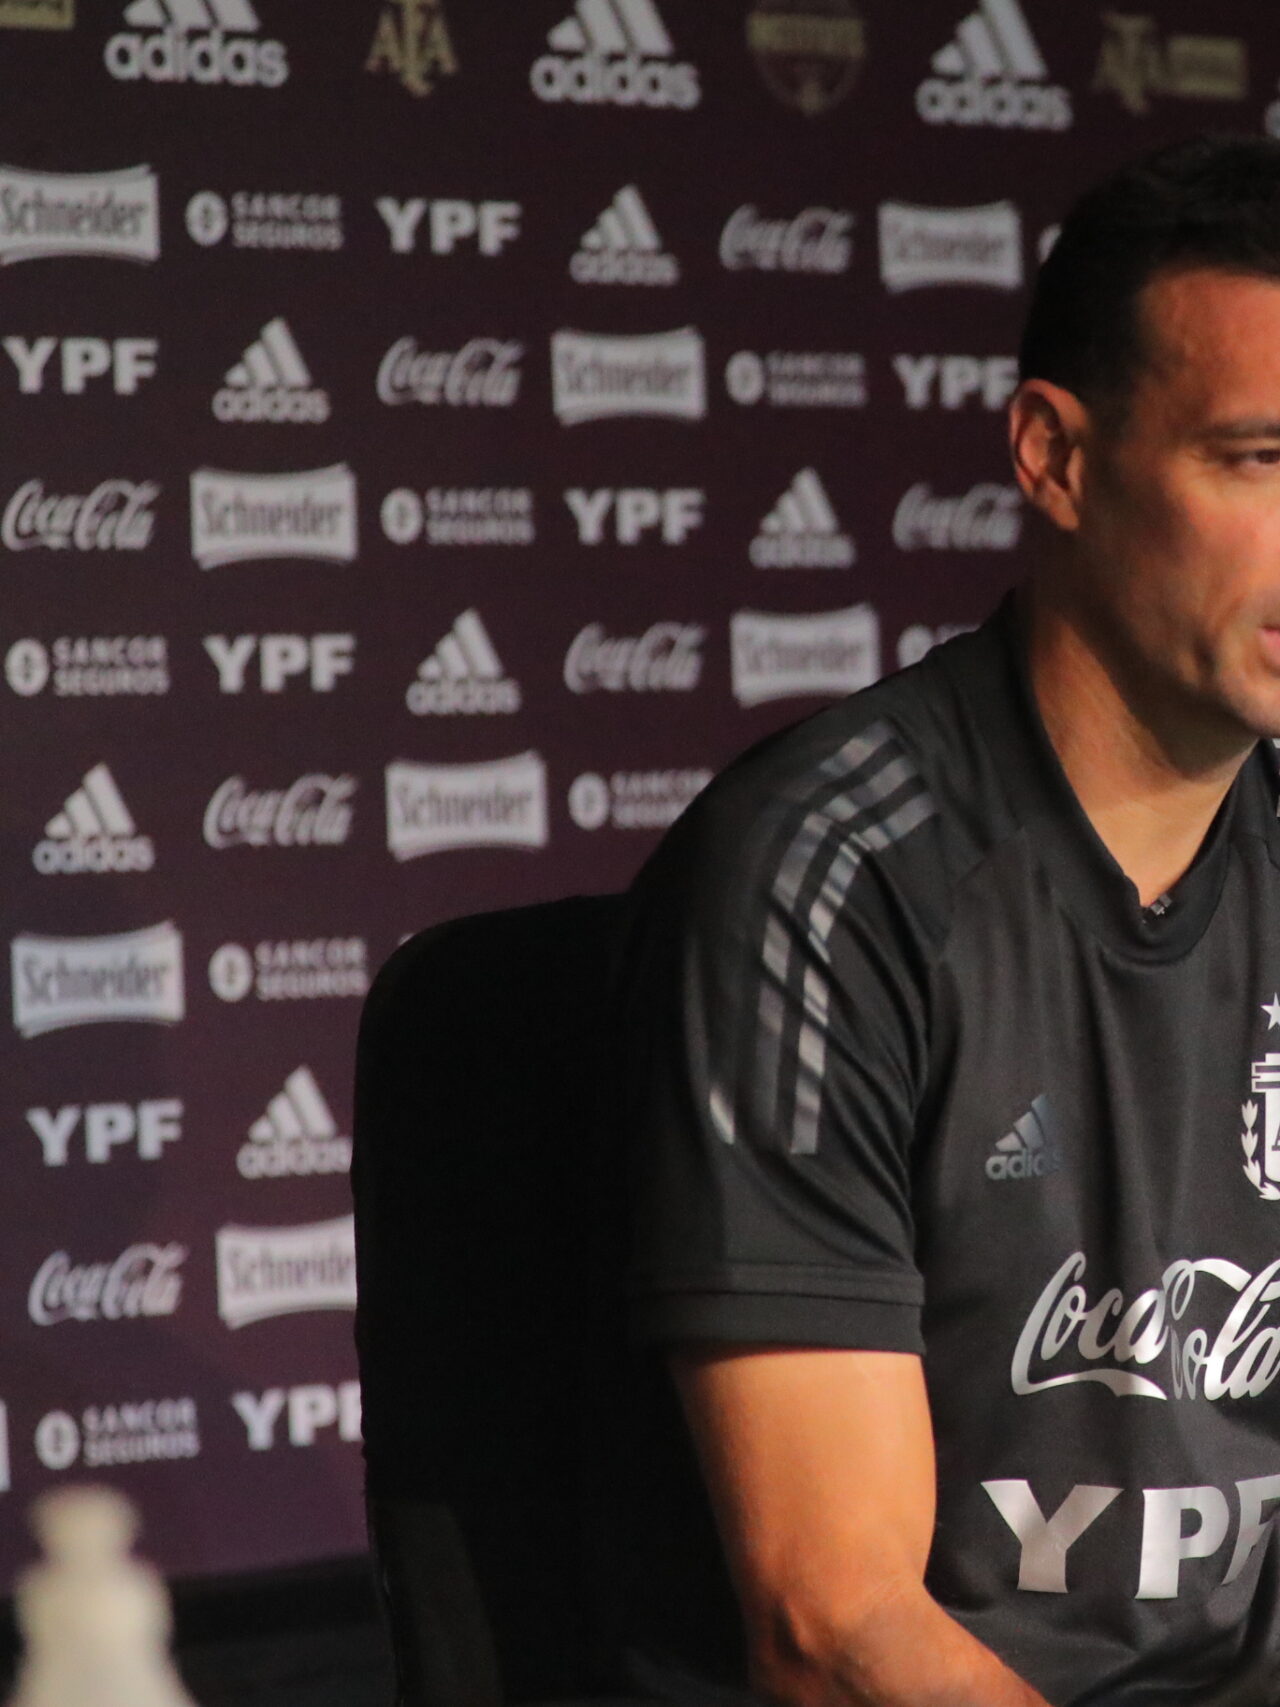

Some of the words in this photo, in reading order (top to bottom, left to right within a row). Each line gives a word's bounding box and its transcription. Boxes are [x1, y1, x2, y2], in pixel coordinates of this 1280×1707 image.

[105, 31, 289, 88] adidas
[530, 56, 701, 109] adidas
[916, 78, 1072, 130] adidas
[233, 193, 340, 221] SANCOR
[377, 198, 519, 255] YPF
[234, 222, 343, 250] SEGUROS
[570, 250, 679, 285] adidas
[4, 337, 157, 394] YPF
[376, 338, 521, 406] Coca-Cola
[894, 355, 1018, 409] YPF
[211, 388, 331, 423] adidas
[1, 480, 158, 550] Coca-Cola
[202, 498, 344, 540] Schneider
[425, 488, 533, 515] SANCOR
[566, 489, 702, 544] YPF
[425, 516, 535, 545] SEGUROS
[749, 534, 855, 568] adidas
[53, 638, 166, 667] SANCOR
[205, 635, 354, 692] YPF
[564, 623, 703, 692] Coca-Cola
[53, 668, 170, 696] SEGUROS
[407, 679, 522, 715] adidas
[203, 775, 354, 848] Coca-Cola
[396, 788, 535, 832] Schneider
[34, 837, 155, 873] adidas
[21, 946, 169, 1002] Schneider
[257, 940, 364, 970] SANCOR
[257, 970, 366, 1000] SEGUROS
[28, 1100, 183, 1165] YPF
[236, 1136, 350, 1180] adidas
[28, 1244, 185, 1325] Coca-Cola
[226, 1248, 356, 1300] Schneide
[83, 1398, 194, 1434] SANCOR
[85, 1431, 199, 1467] SEGUROS
